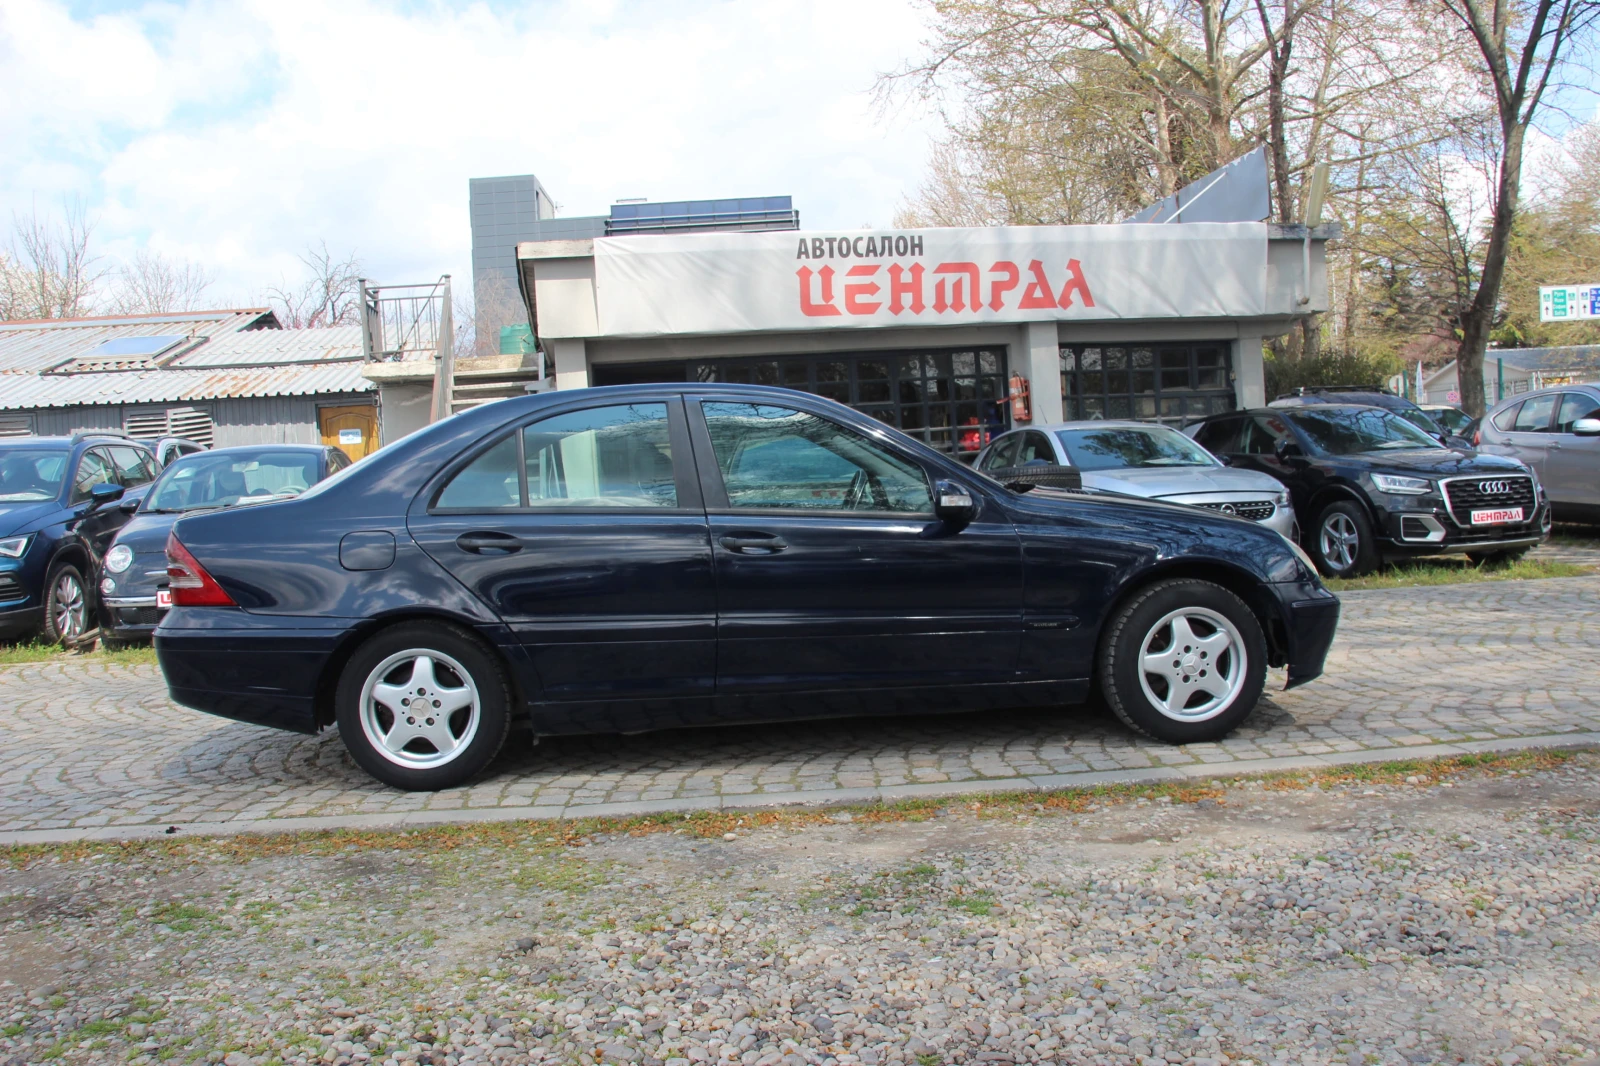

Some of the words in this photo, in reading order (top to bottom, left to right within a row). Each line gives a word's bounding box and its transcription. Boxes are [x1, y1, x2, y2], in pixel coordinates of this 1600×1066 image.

[796, 235, 923, 260] АВТОСАЛОН
[795, 258, 1096, 317] ЦЕНТРАЛ
[1473, 510, 1520, 522] ЦЕНТРАЛ
